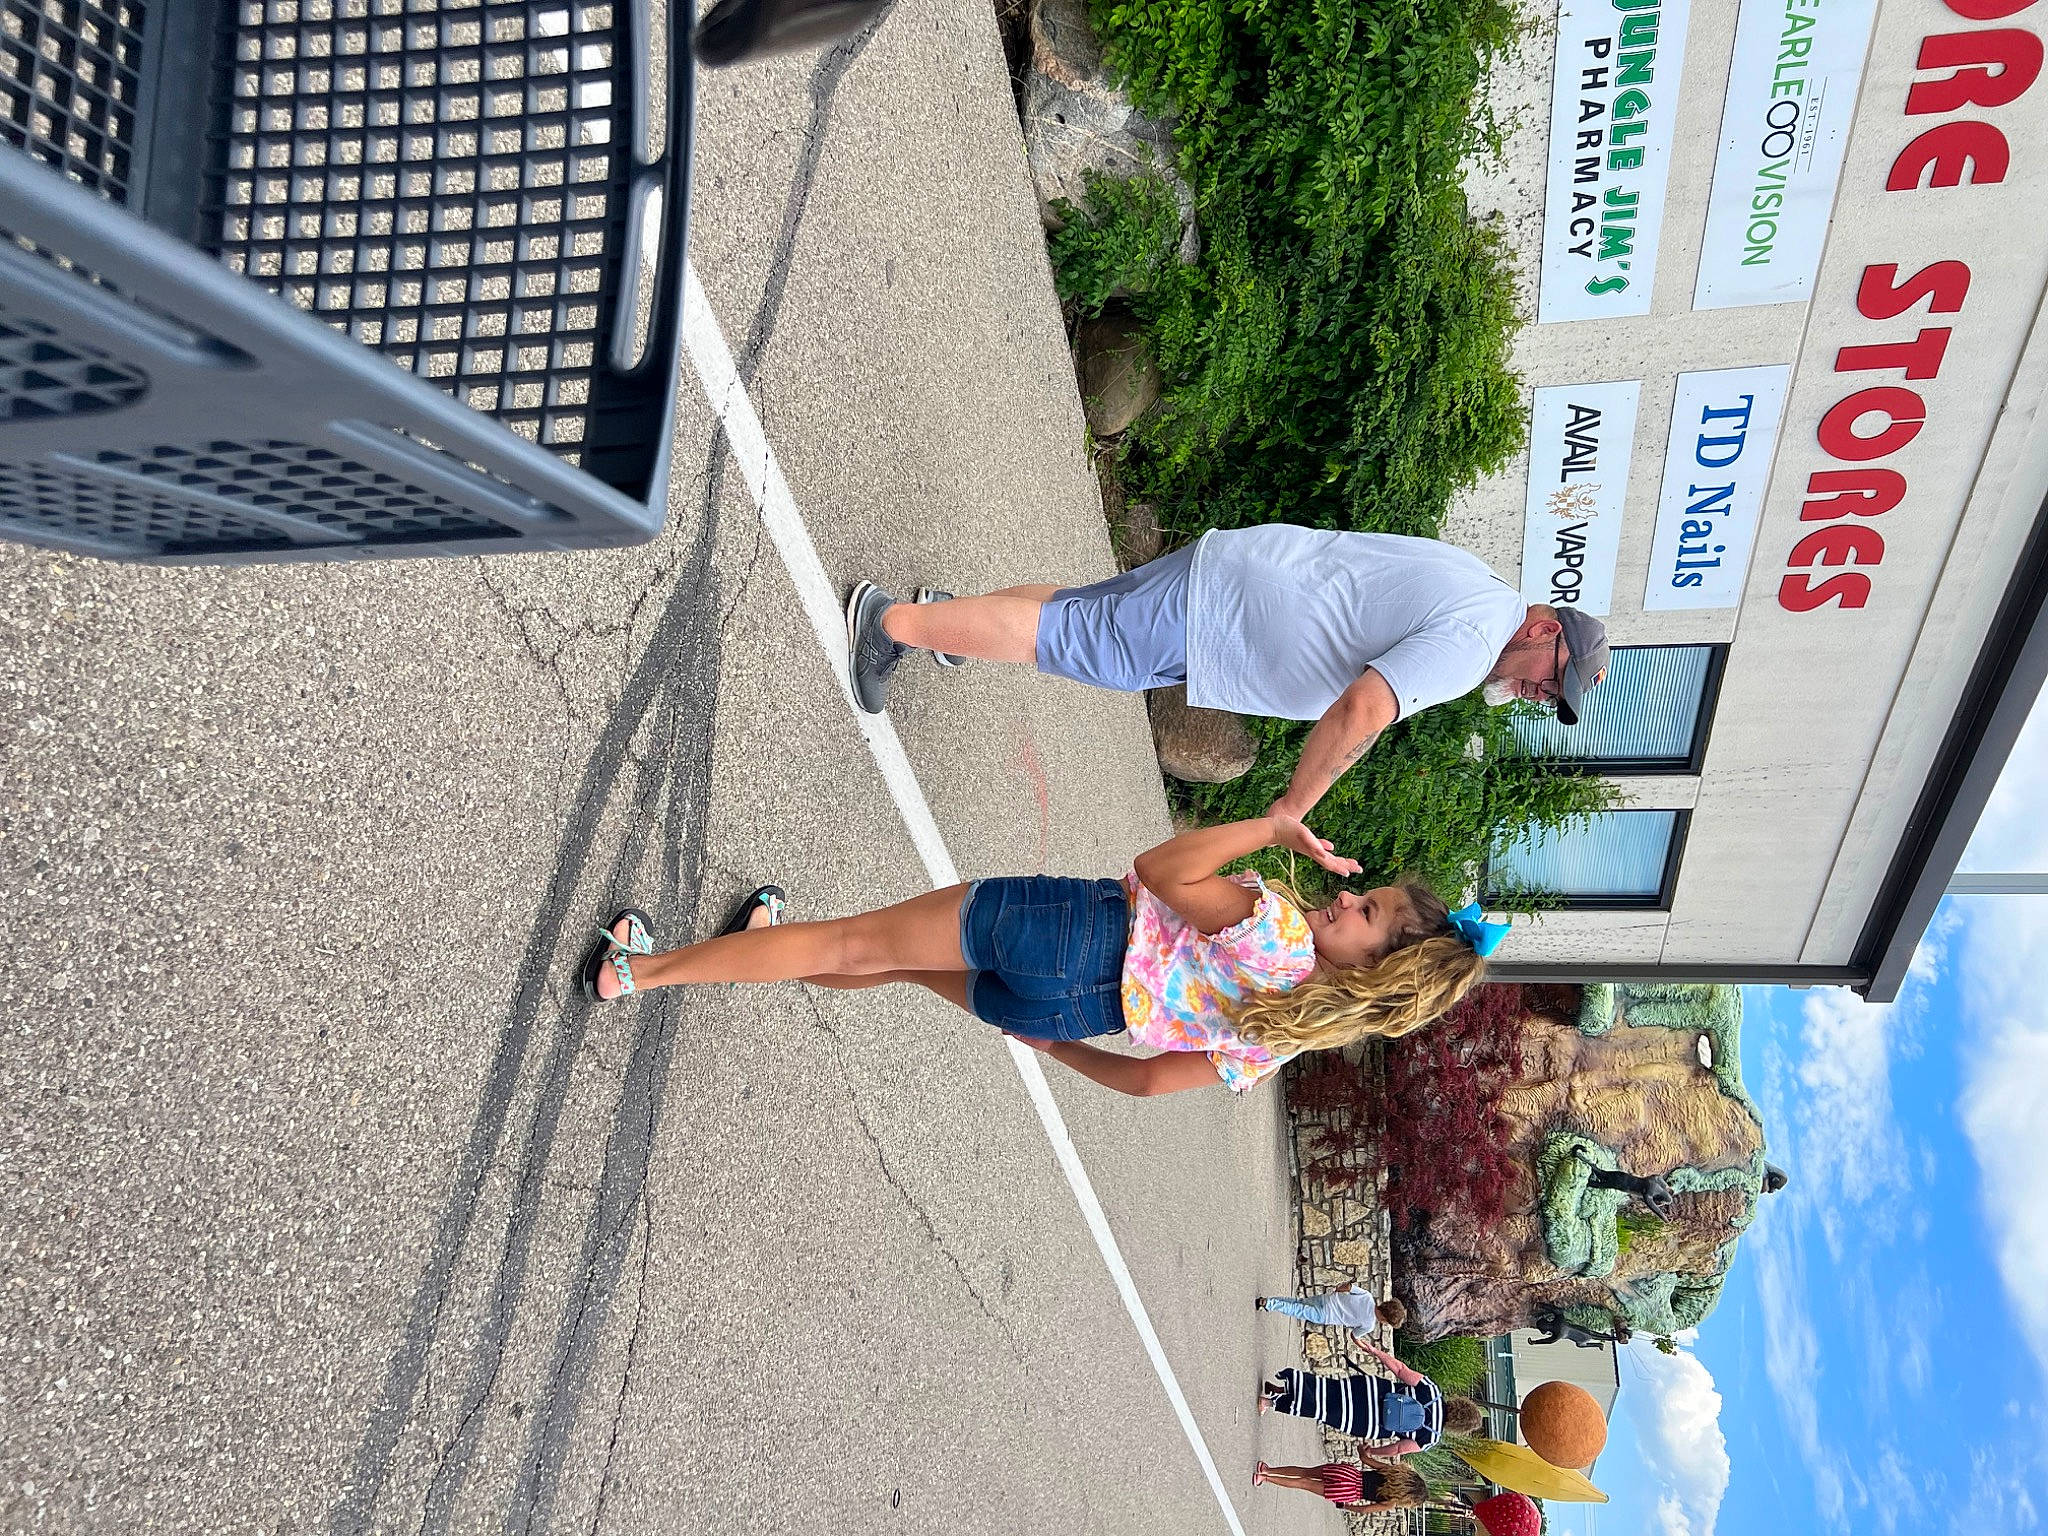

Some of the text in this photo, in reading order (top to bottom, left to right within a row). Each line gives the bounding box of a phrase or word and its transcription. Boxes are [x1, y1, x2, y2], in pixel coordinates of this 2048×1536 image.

[1567, 38, 1611, 258] PHARMACY
[1585, 187, 1640, 297] JIM'S
[1742, 160, 1788, 266] VISION
[1778, 0, 2043, 613] RE STORES
[1549, 404, 1601, 605] AVAIL VAPOR
[1671, 395, 1753, 588] TD Nails
